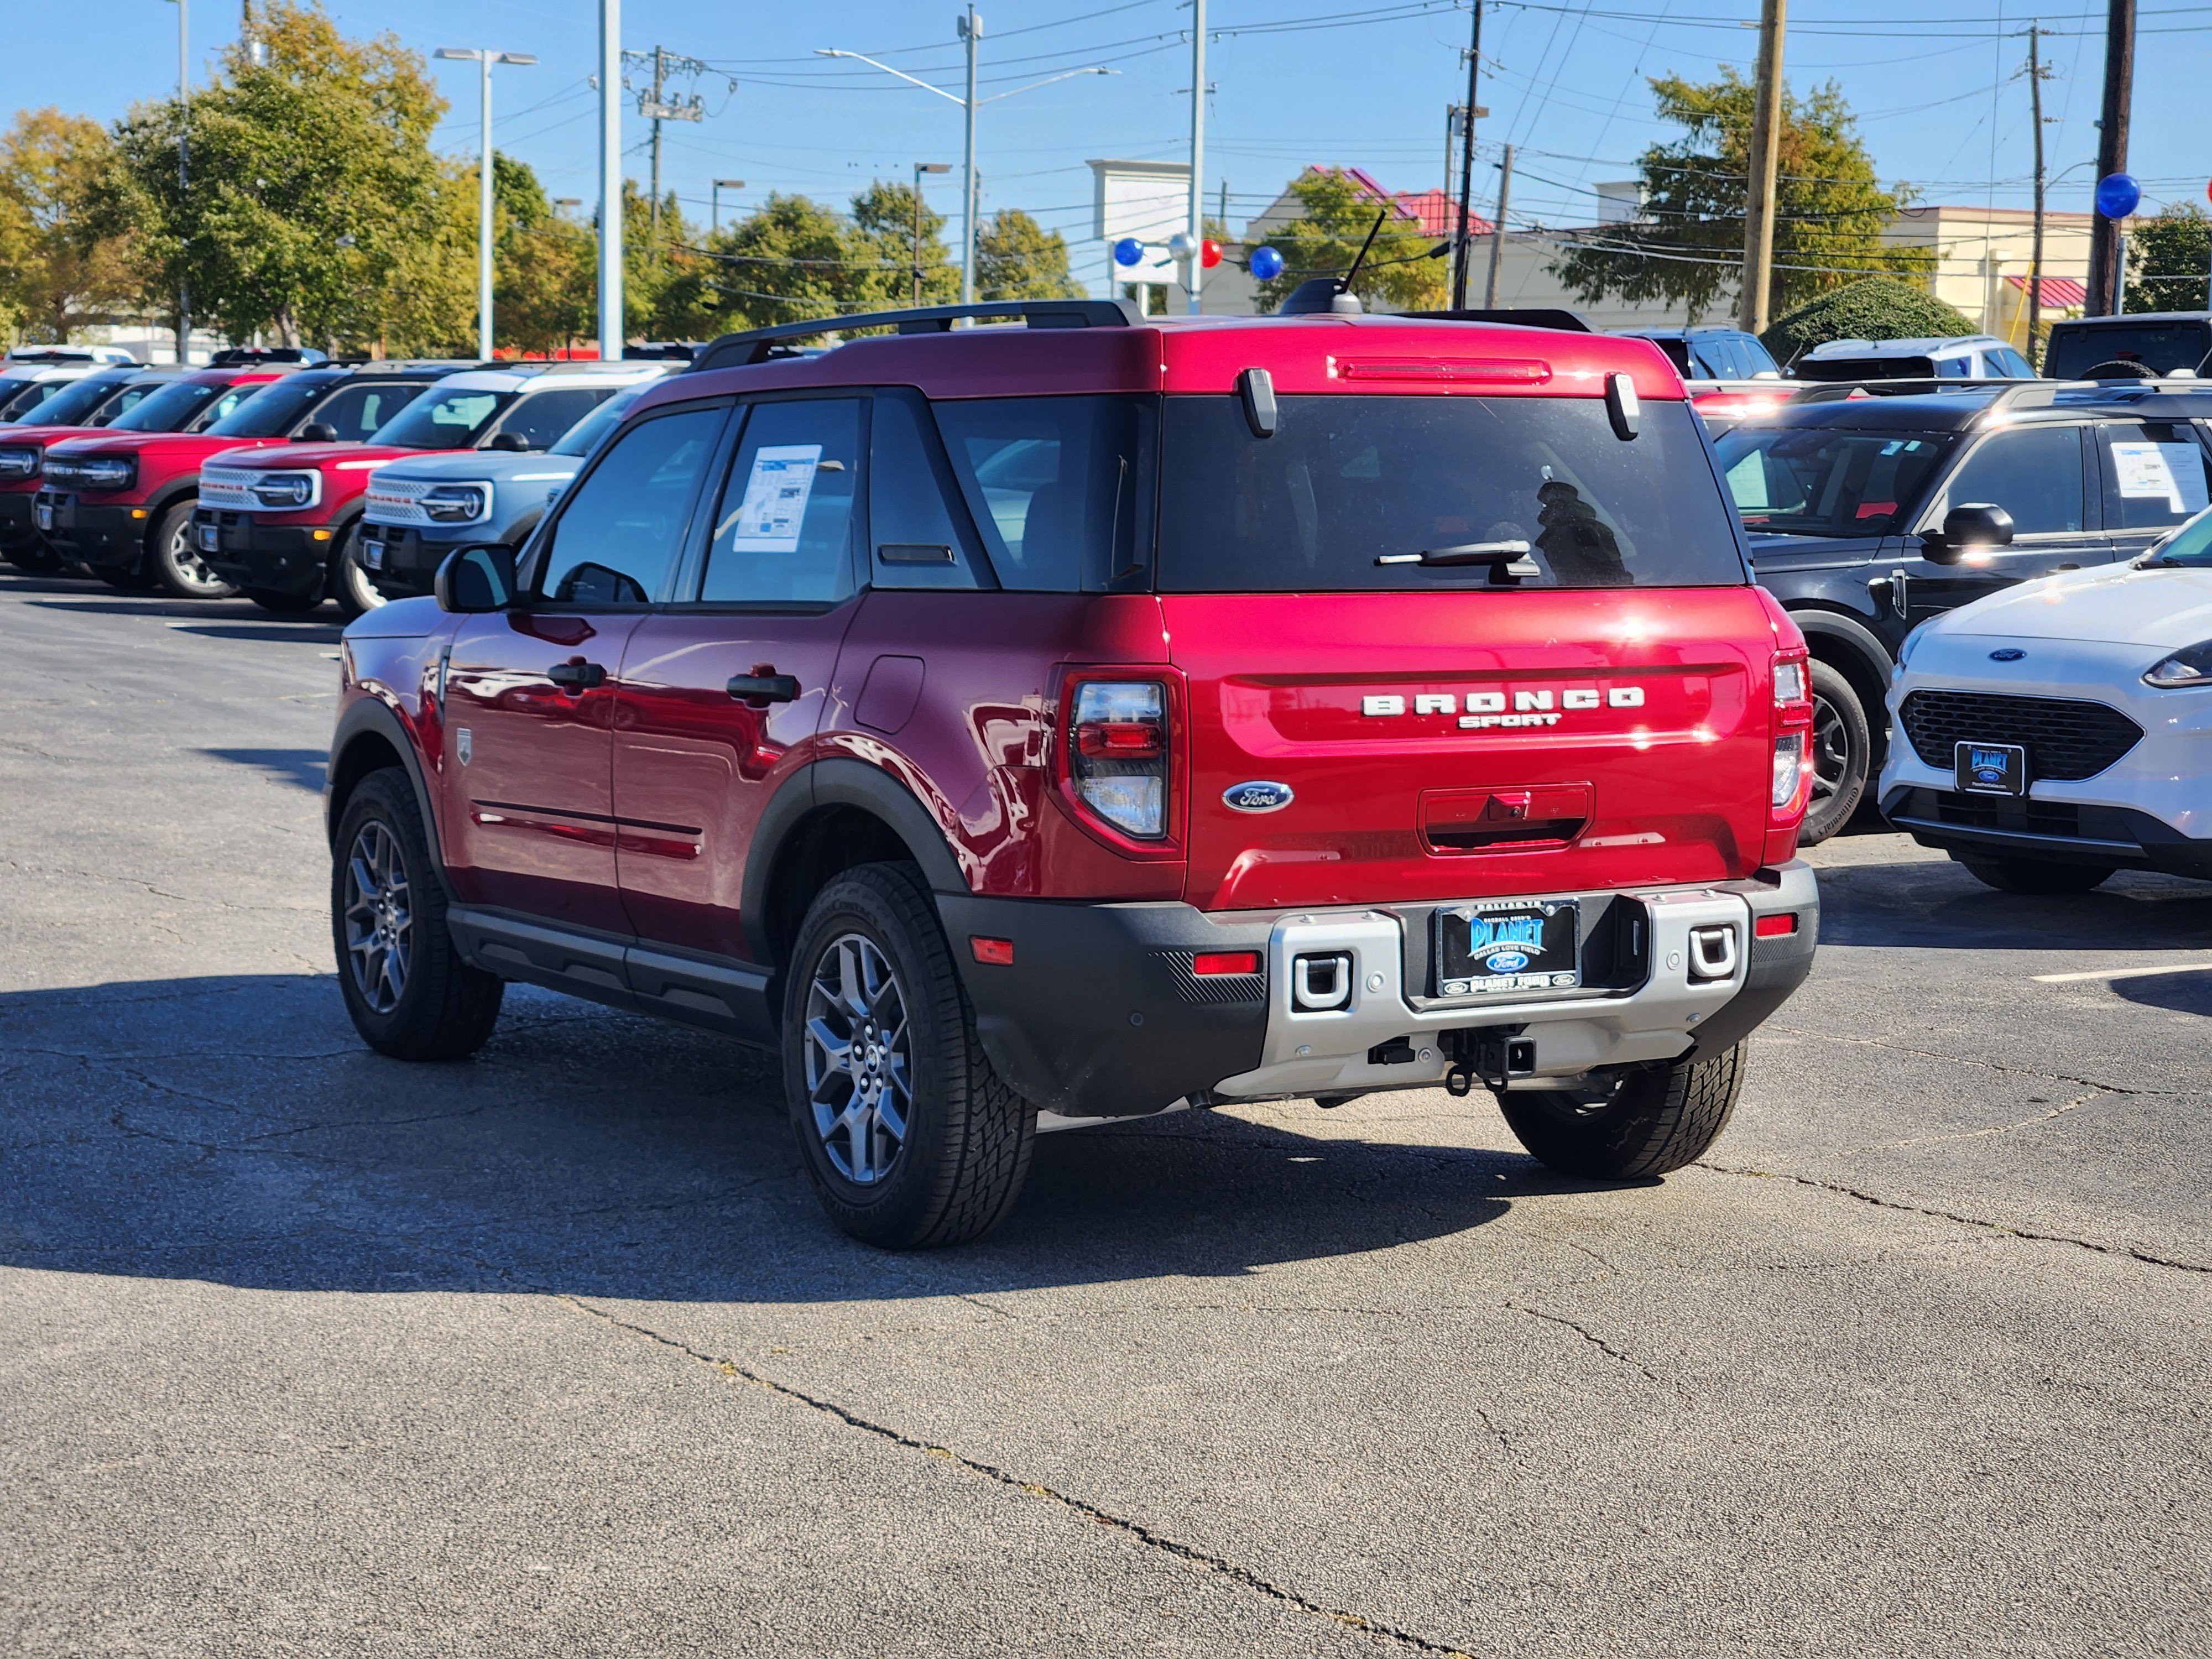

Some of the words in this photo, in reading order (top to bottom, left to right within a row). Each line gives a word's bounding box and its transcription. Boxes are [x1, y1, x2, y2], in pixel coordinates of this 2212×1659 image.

[1362, 687, 1645, 716] BRONCO
[1458, 712, 1562, 728] SPORT
[1971, 748, 2008, 771] PLANET
[1470, 916, 1545, 953] PLANET
[1473, 946, 1501, 961] DALLAS
[1520, 945, 1541, 956] FIELD
[1470, 977, 1516, 993] PLANET
[1517, 975, 1551, 987] FORD
